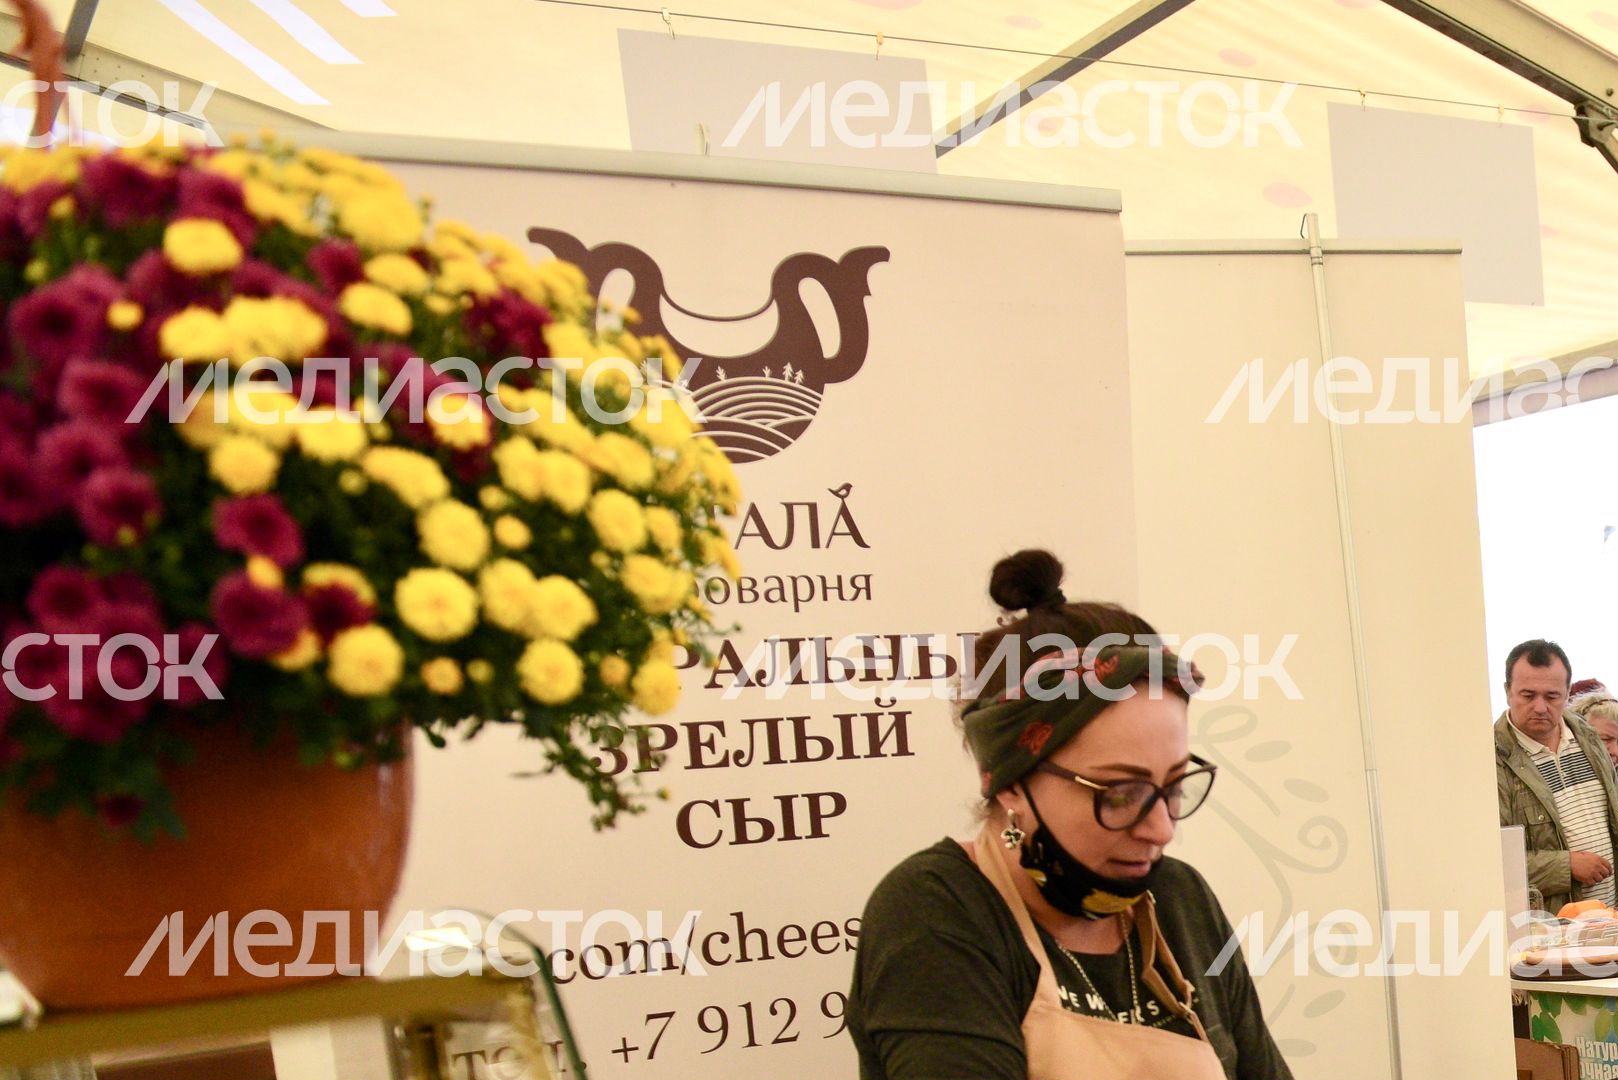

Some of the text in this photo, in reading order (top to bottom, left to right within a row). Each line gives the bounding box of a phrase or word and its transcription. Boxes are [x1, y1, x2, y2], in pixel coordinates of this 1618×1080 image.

[695, 573, 873, 613] оварня
[589, 696, 916, 777] ЗРЕЛЫЙ
[675, 791, 848, 850] СЫР
[611, 1010, 677, 1065] +7
[696, 997, 801, 1054] 912
